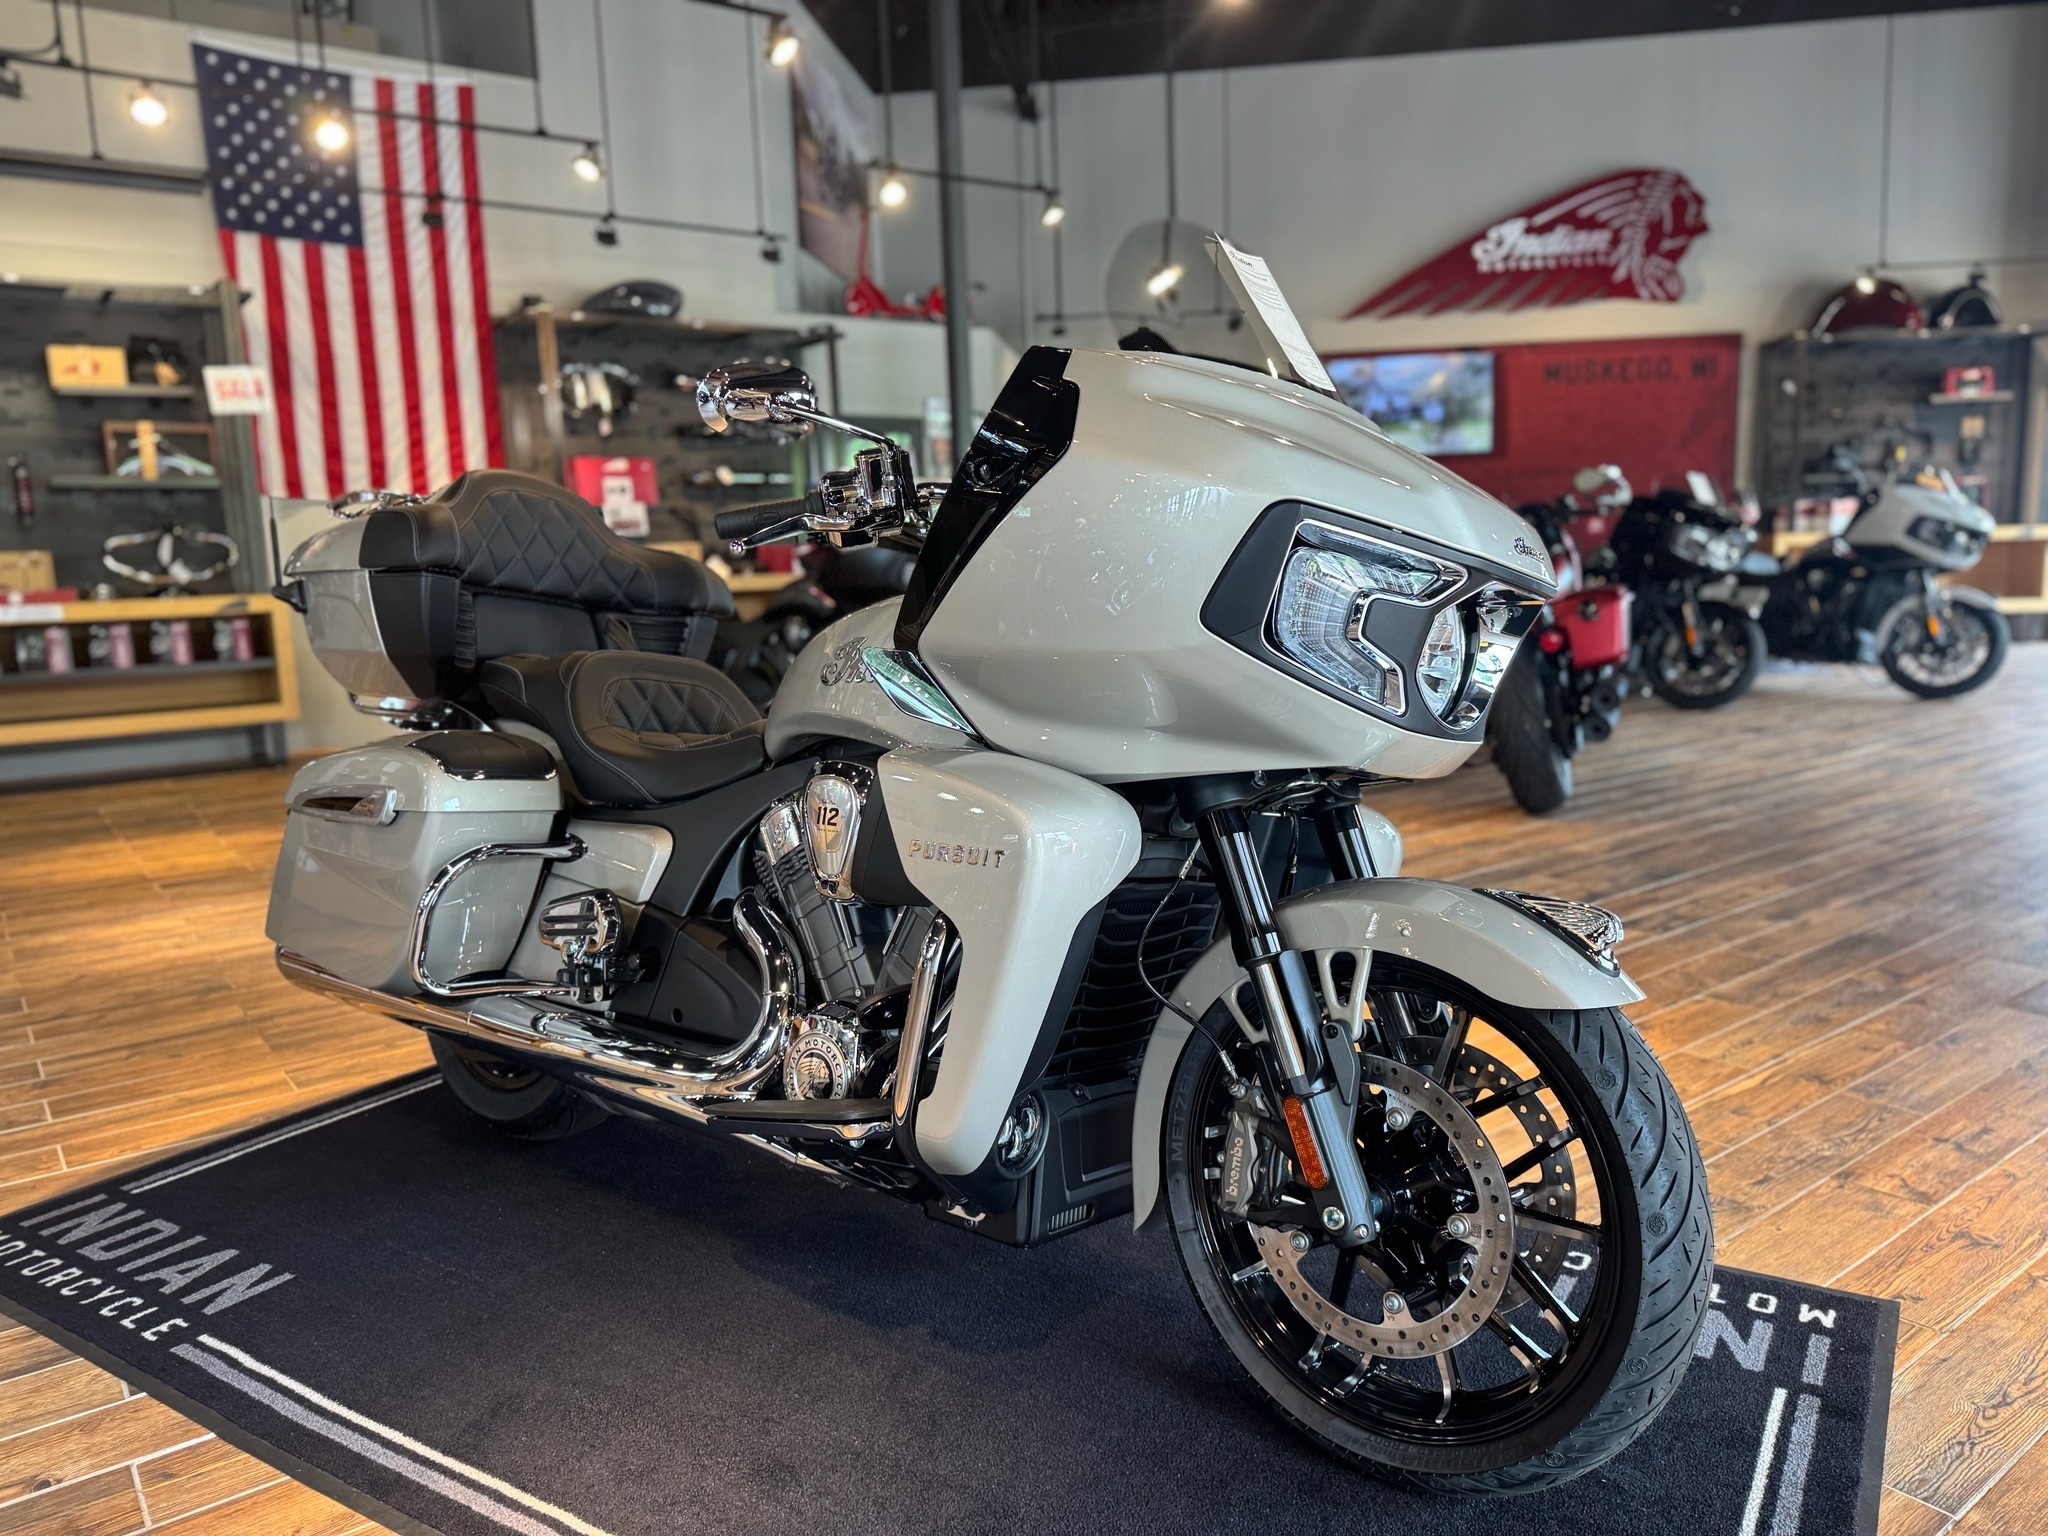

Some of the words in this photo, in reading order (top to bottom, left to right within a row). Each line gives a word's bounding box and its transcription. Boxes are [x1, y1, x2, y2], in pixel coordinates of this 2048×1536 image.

[1471, 217, 1613, 263] Indian
[816, 805, 840, 827] 112
[908, 838, 1006, 869] PURSUIT
[804, 1038, 843, 1098] MOTORCYCL
[1225, 1136, 1244, 1198] brembo
[19, 1193, 296, 1316] INDIAN
[0, 1229, 190, 1342] OTORCYCLE
